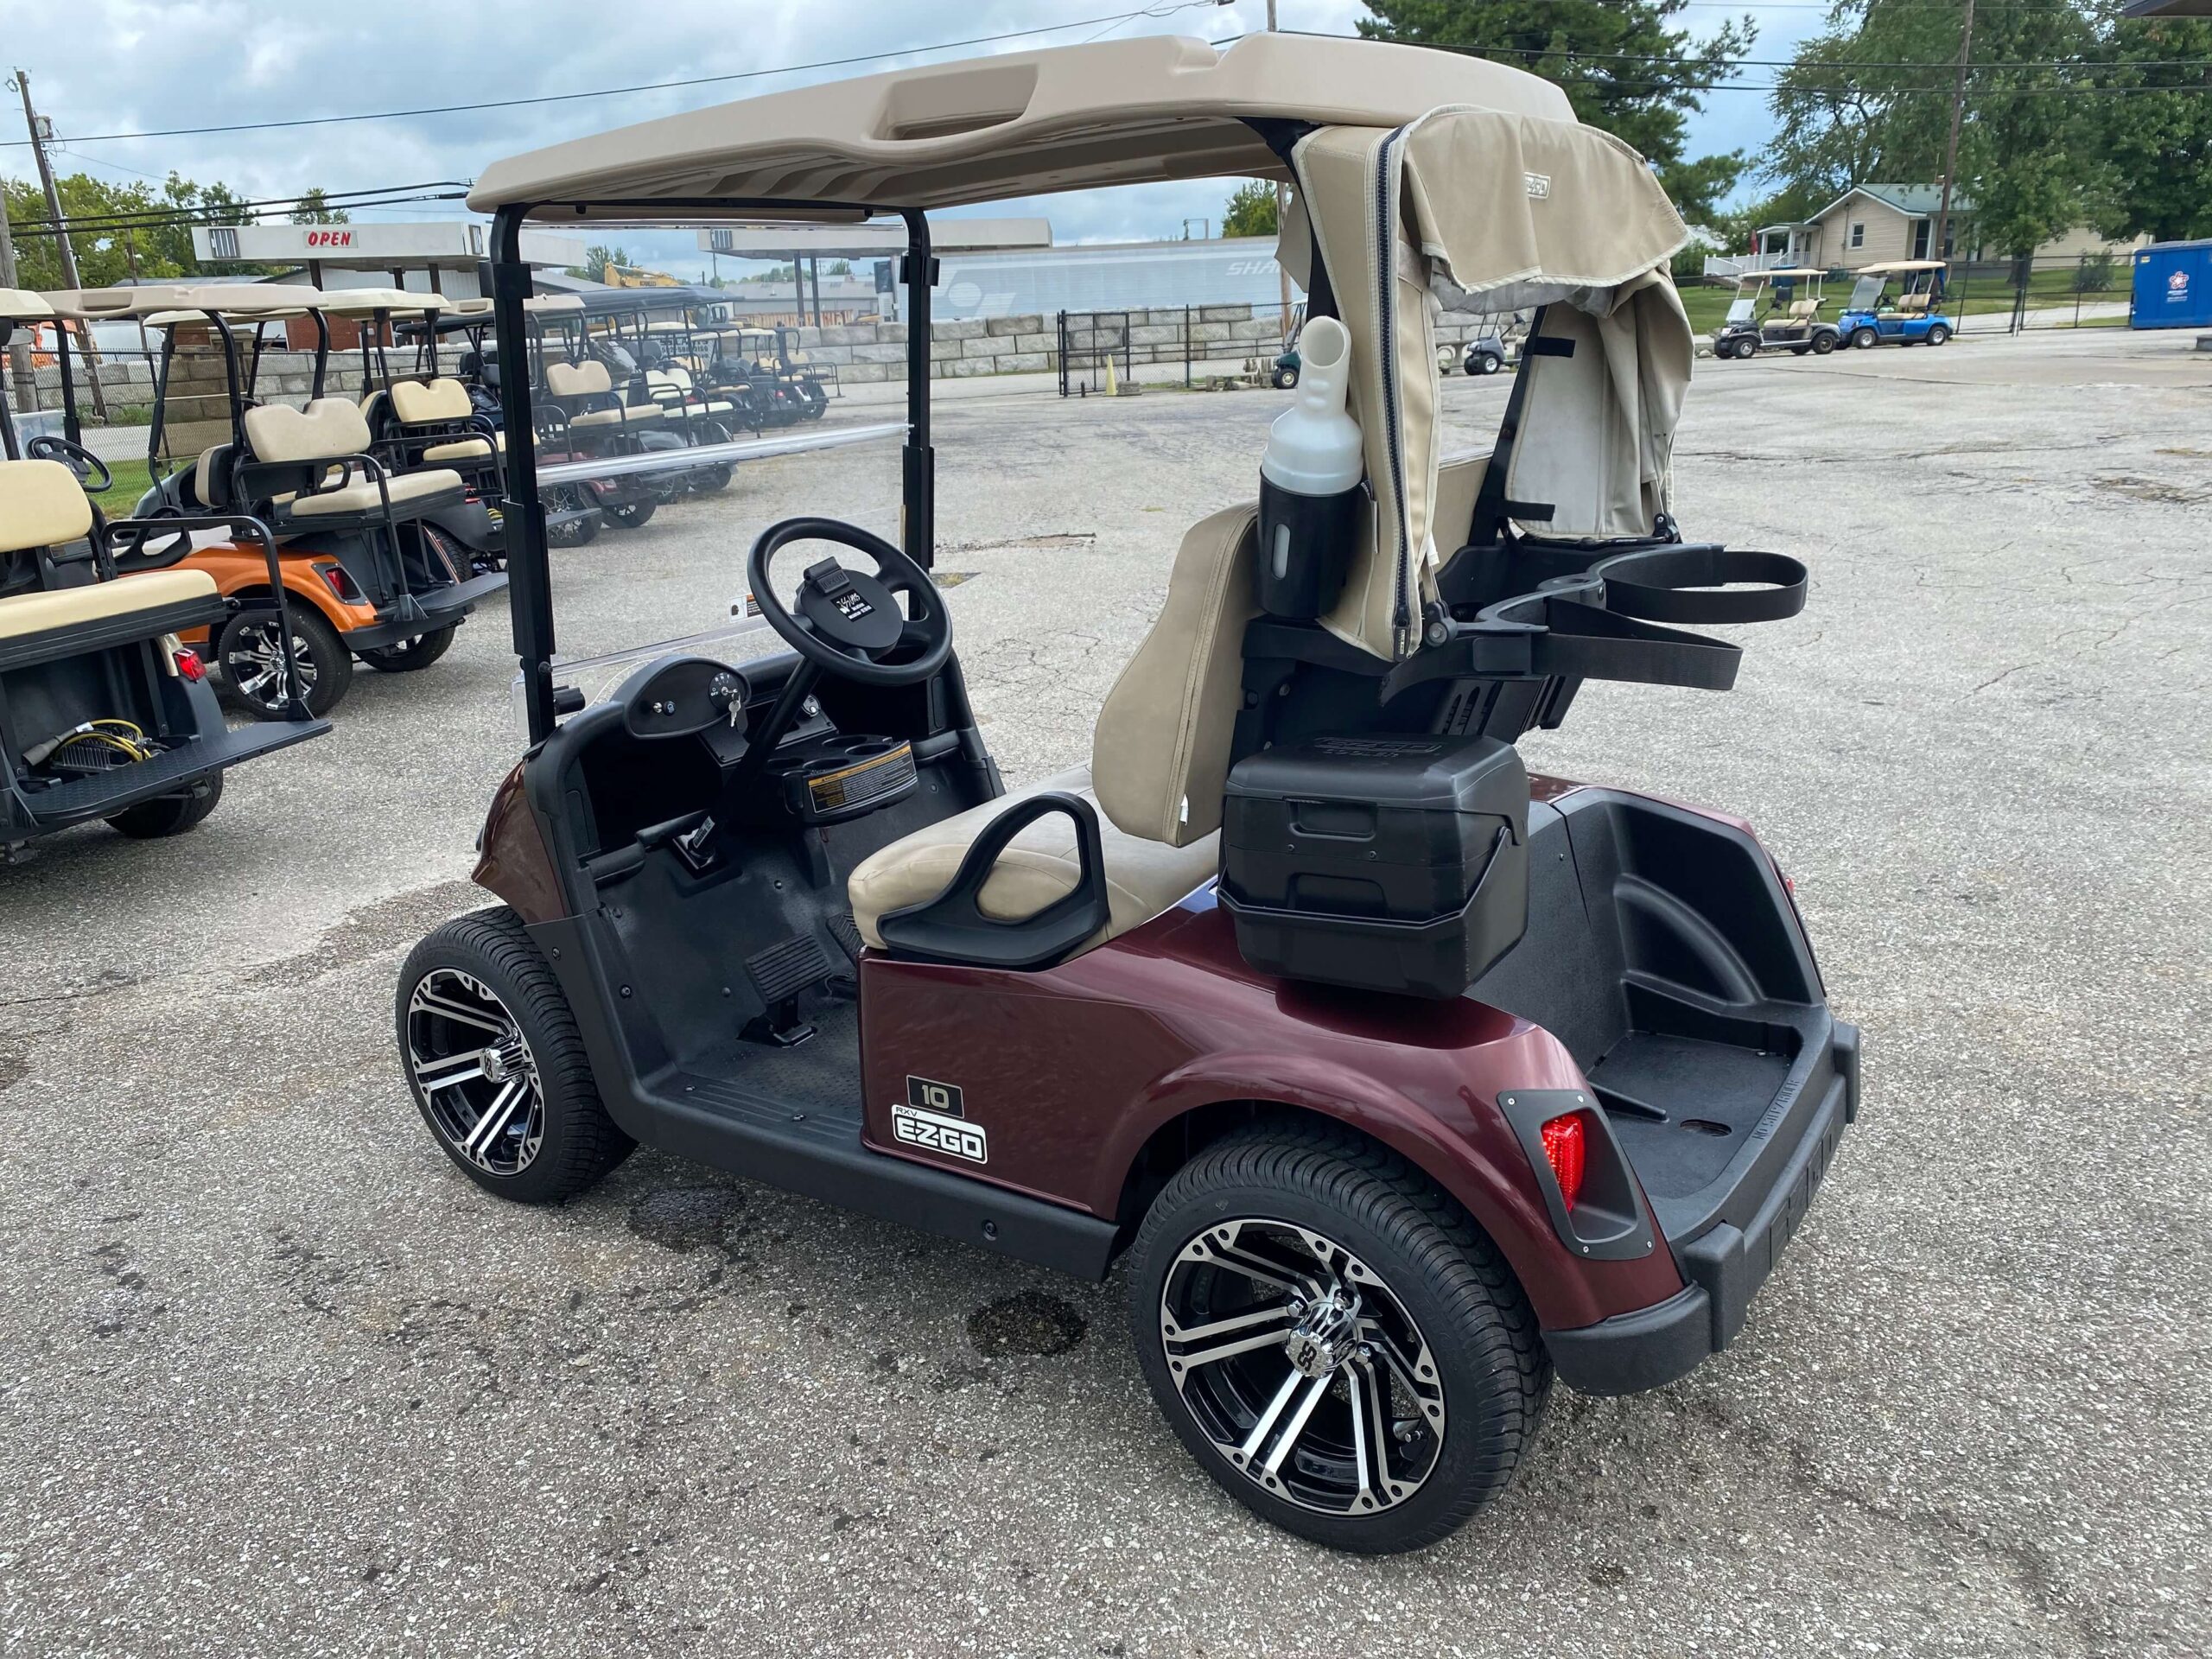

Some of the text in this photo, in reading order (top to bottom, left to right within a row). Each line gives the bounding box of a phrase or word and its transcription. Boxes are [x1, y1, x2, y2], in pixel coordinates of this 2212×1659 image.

[1525, 176, 1548, 195] ZGO
[308, 231, 351, 246] OPEN
[921, 1084, 950, 1109] 10
[895, 1106, 918, 1117] RXV
[896, 1116, 983, 1159] EZGO
